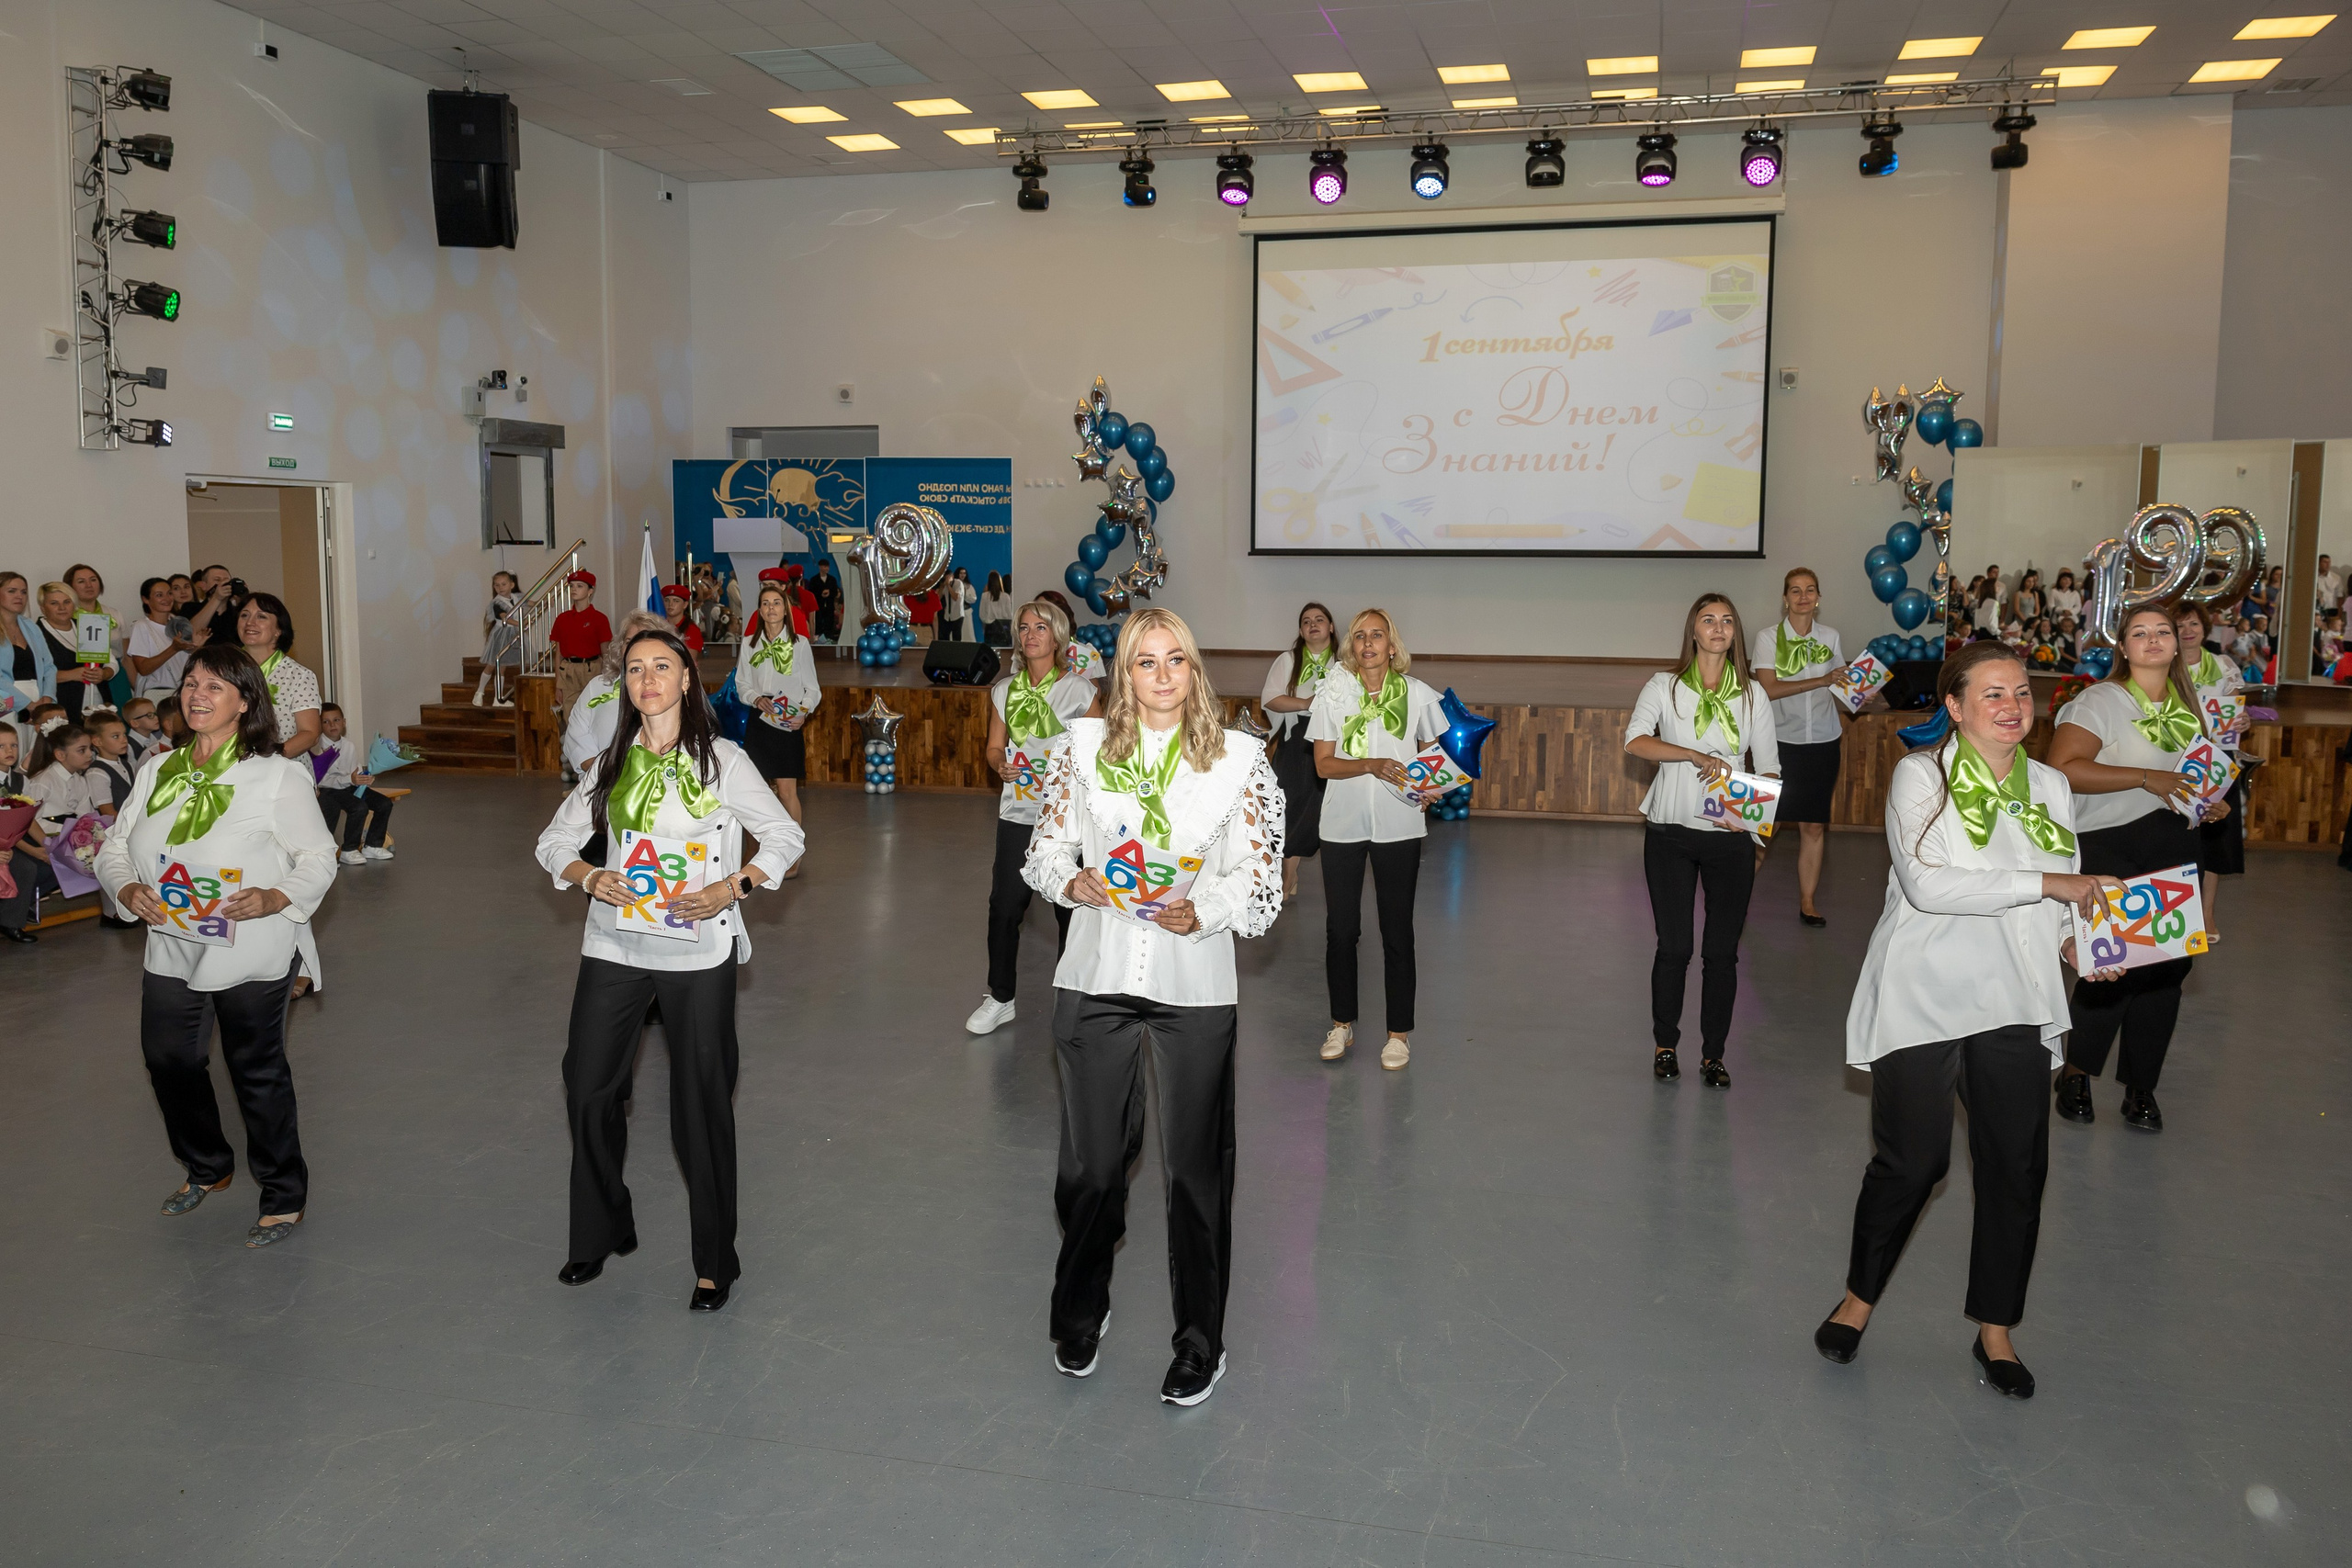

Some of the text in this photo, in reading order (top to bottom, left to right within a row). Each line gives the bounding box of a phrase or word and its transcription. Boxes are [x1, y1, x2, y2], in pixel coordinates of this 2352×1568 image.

[1453, 366, 1659, 427] с Днем
[271, 458, 295, 467] ВЫХОД
[1383, 414, 1617, 474] Знаний!
